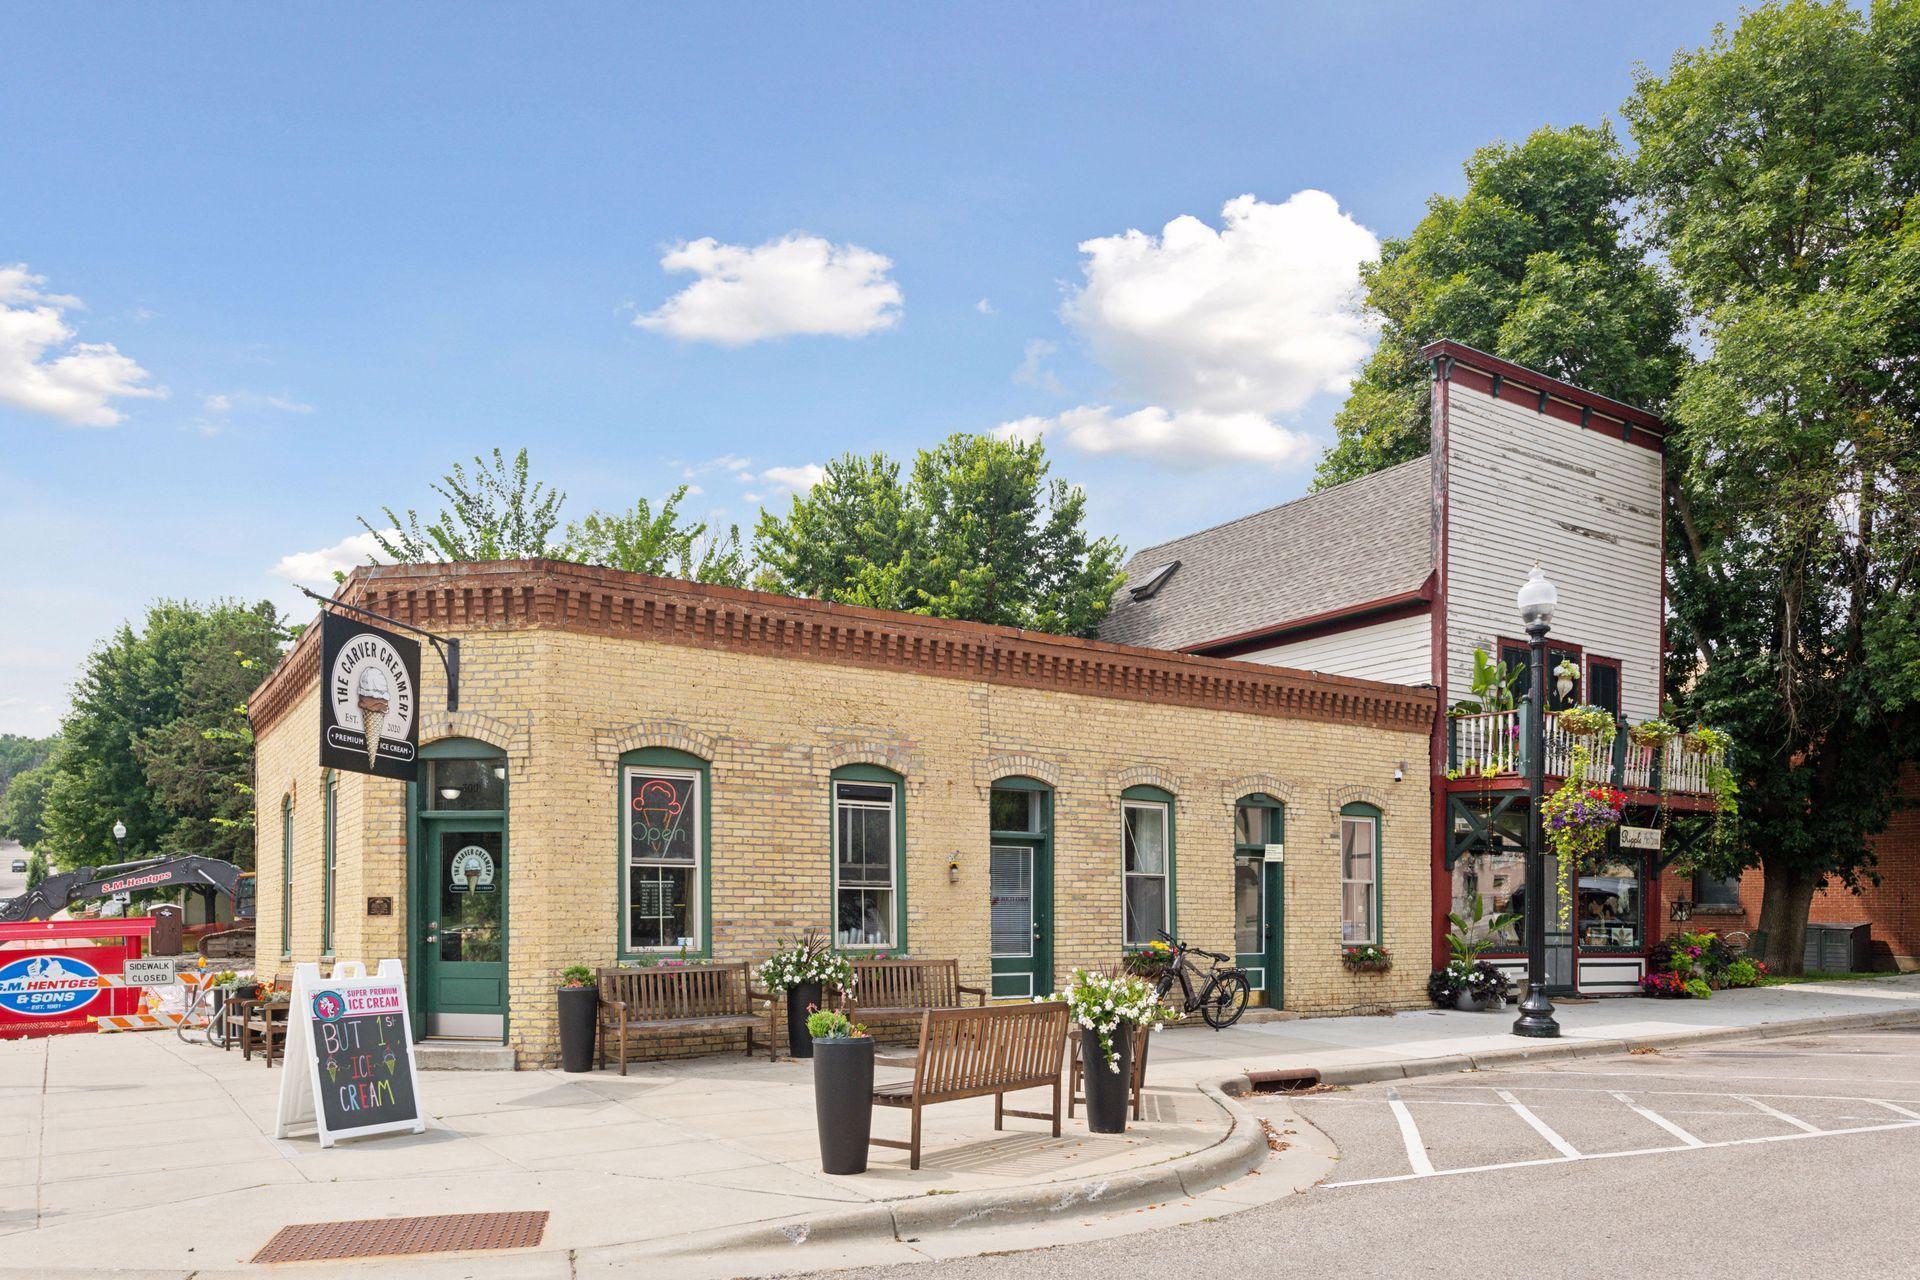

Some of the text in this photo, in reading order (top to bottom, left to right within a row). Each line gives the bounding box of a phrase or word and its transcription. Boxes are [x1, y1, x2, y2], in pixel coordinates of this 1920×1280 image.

[337, 642, 409, 722] THE CARVER CREAMERY
[345, 713, 359, 724] EST.
[335, 733, 409, 754] PREMIUM ICE CREAM
[631, 821, 686, 846] Open
[127, 872, 172, 887] Hentges
[26, 978, 98, 991] HENTGES
[132, 974, 167, 982] CLOSED
[16, 991, 76, 1004] & SONS
[346, 987, 398, 998] SUPER PREMIUM
[348, 996, 399, 1010] ICE CREAM
[322, 1020, 362, 1054] BUT
[351, 1054, 375, 1079] ICE
[340, 1079, 395, 1112] CREAM
